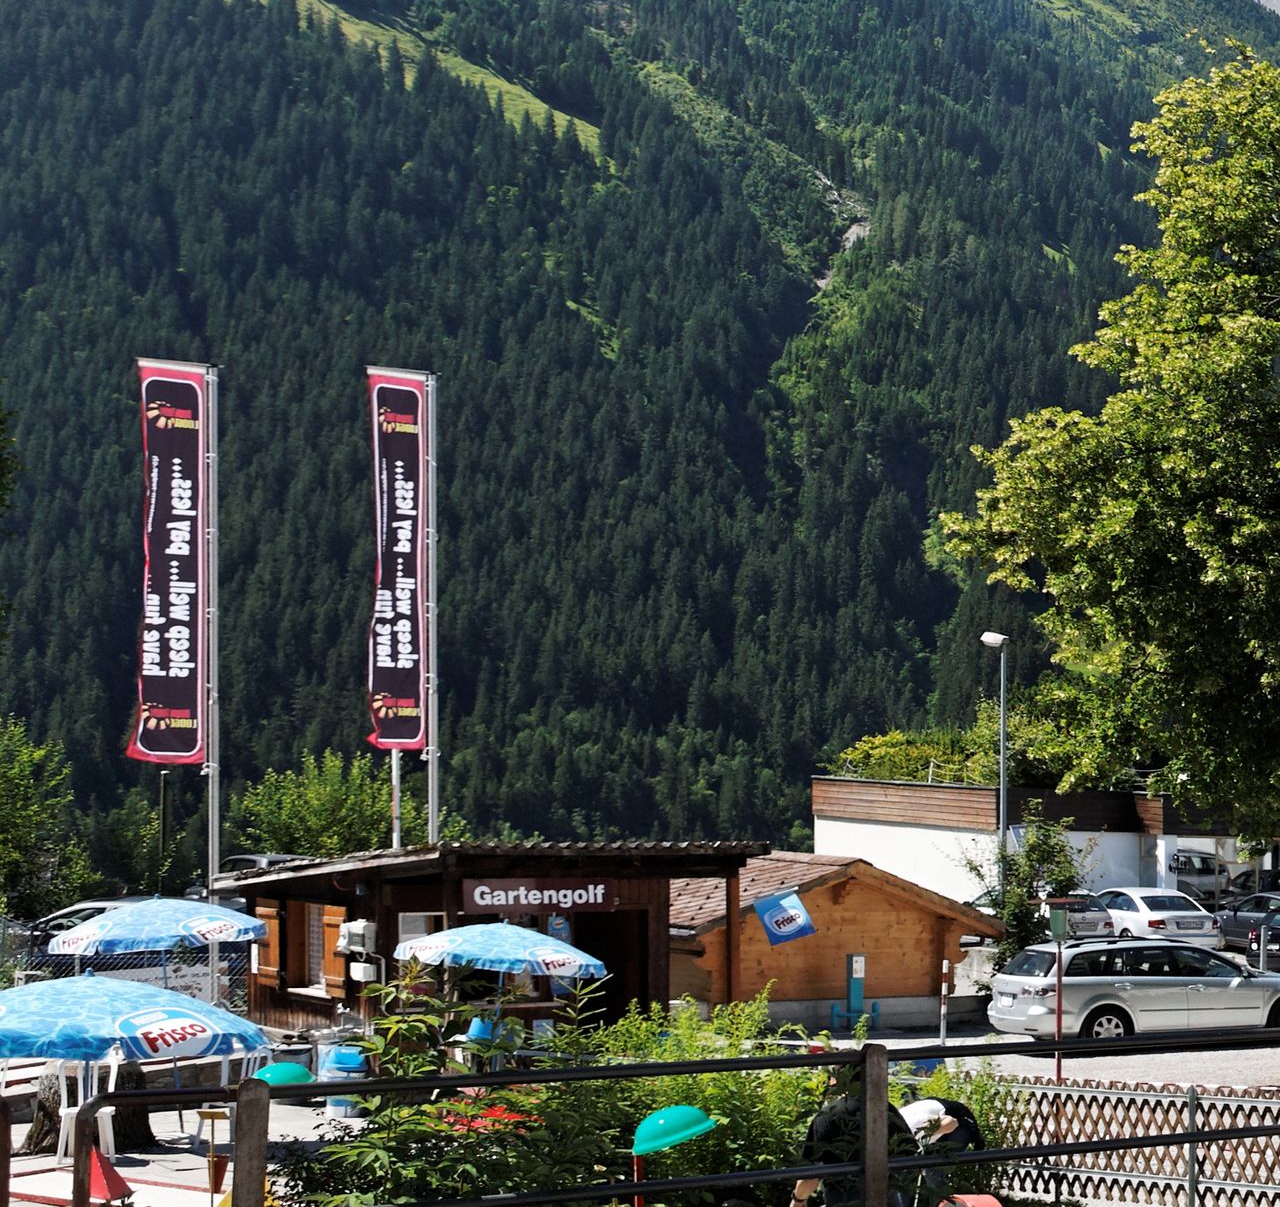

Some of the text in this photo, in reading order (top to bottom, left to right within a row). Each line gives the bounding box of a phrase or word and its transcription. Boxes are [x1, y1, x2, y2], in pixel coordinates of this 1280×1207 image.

[473, 884, 605, 908] Gartengolf
[773, 912, 801, 930] Frisco
[141, 1023, 208, 1054] Frisco
